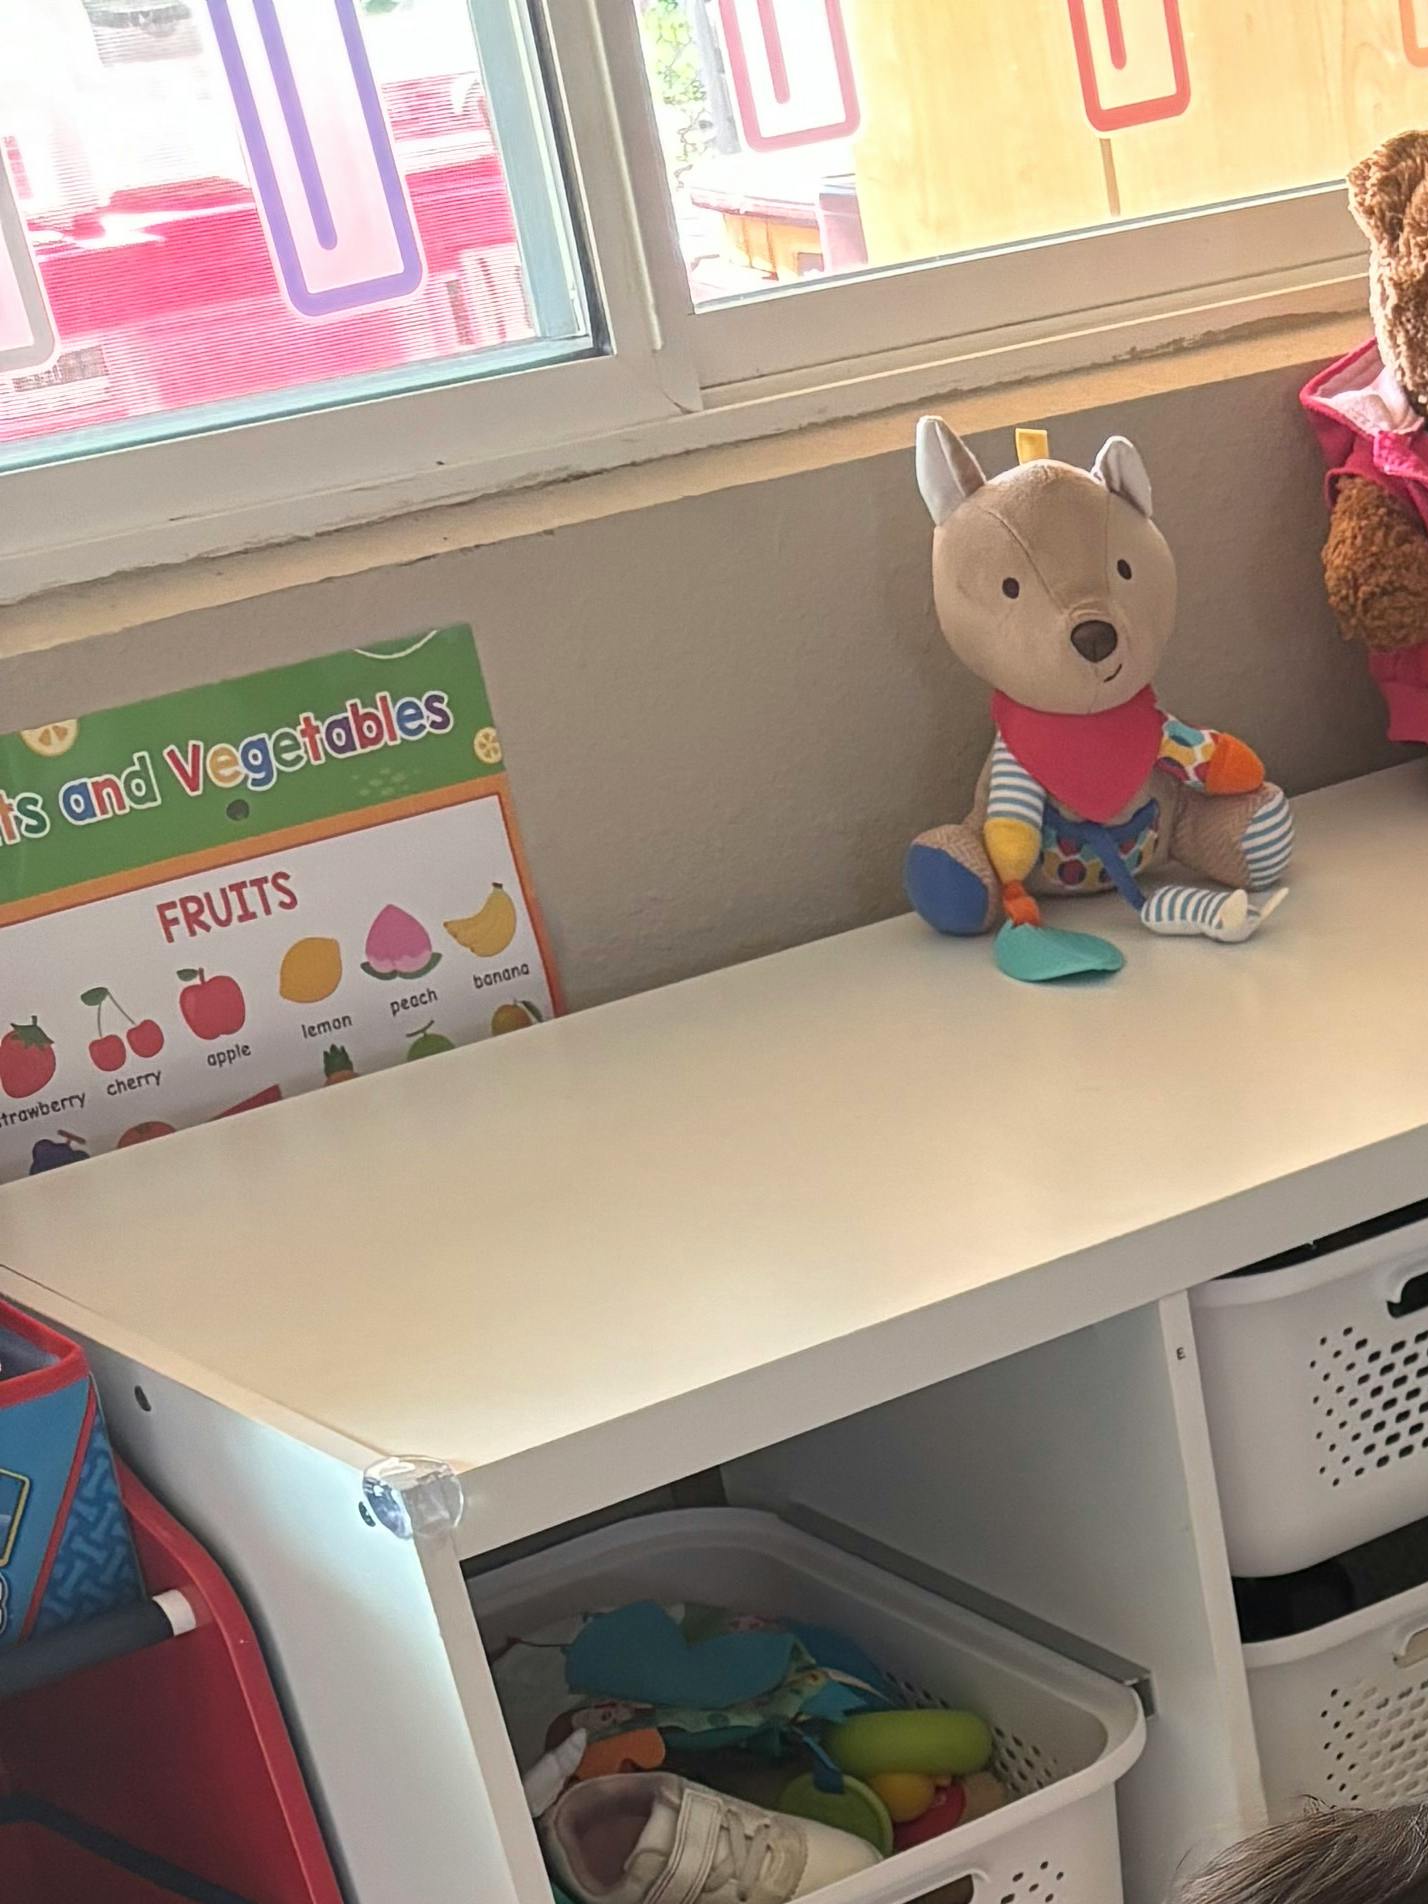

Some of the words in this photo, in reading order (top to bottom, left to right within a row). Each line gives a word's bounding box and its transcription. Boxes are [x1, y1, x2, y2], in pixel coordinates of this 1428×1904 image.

[59, 752, 161, 825] and
[163, 691, 454, 796] Vegetables
[155, 870, 298, 944] FRUITS
[473, 961, 531, 989] banana
[390, 987, 438, 1017] peach
[301, 1012, 352, 1039] lemon
[206, 1042, 252, 1069] apple
[106, 1068, 163, 1098] cherry
